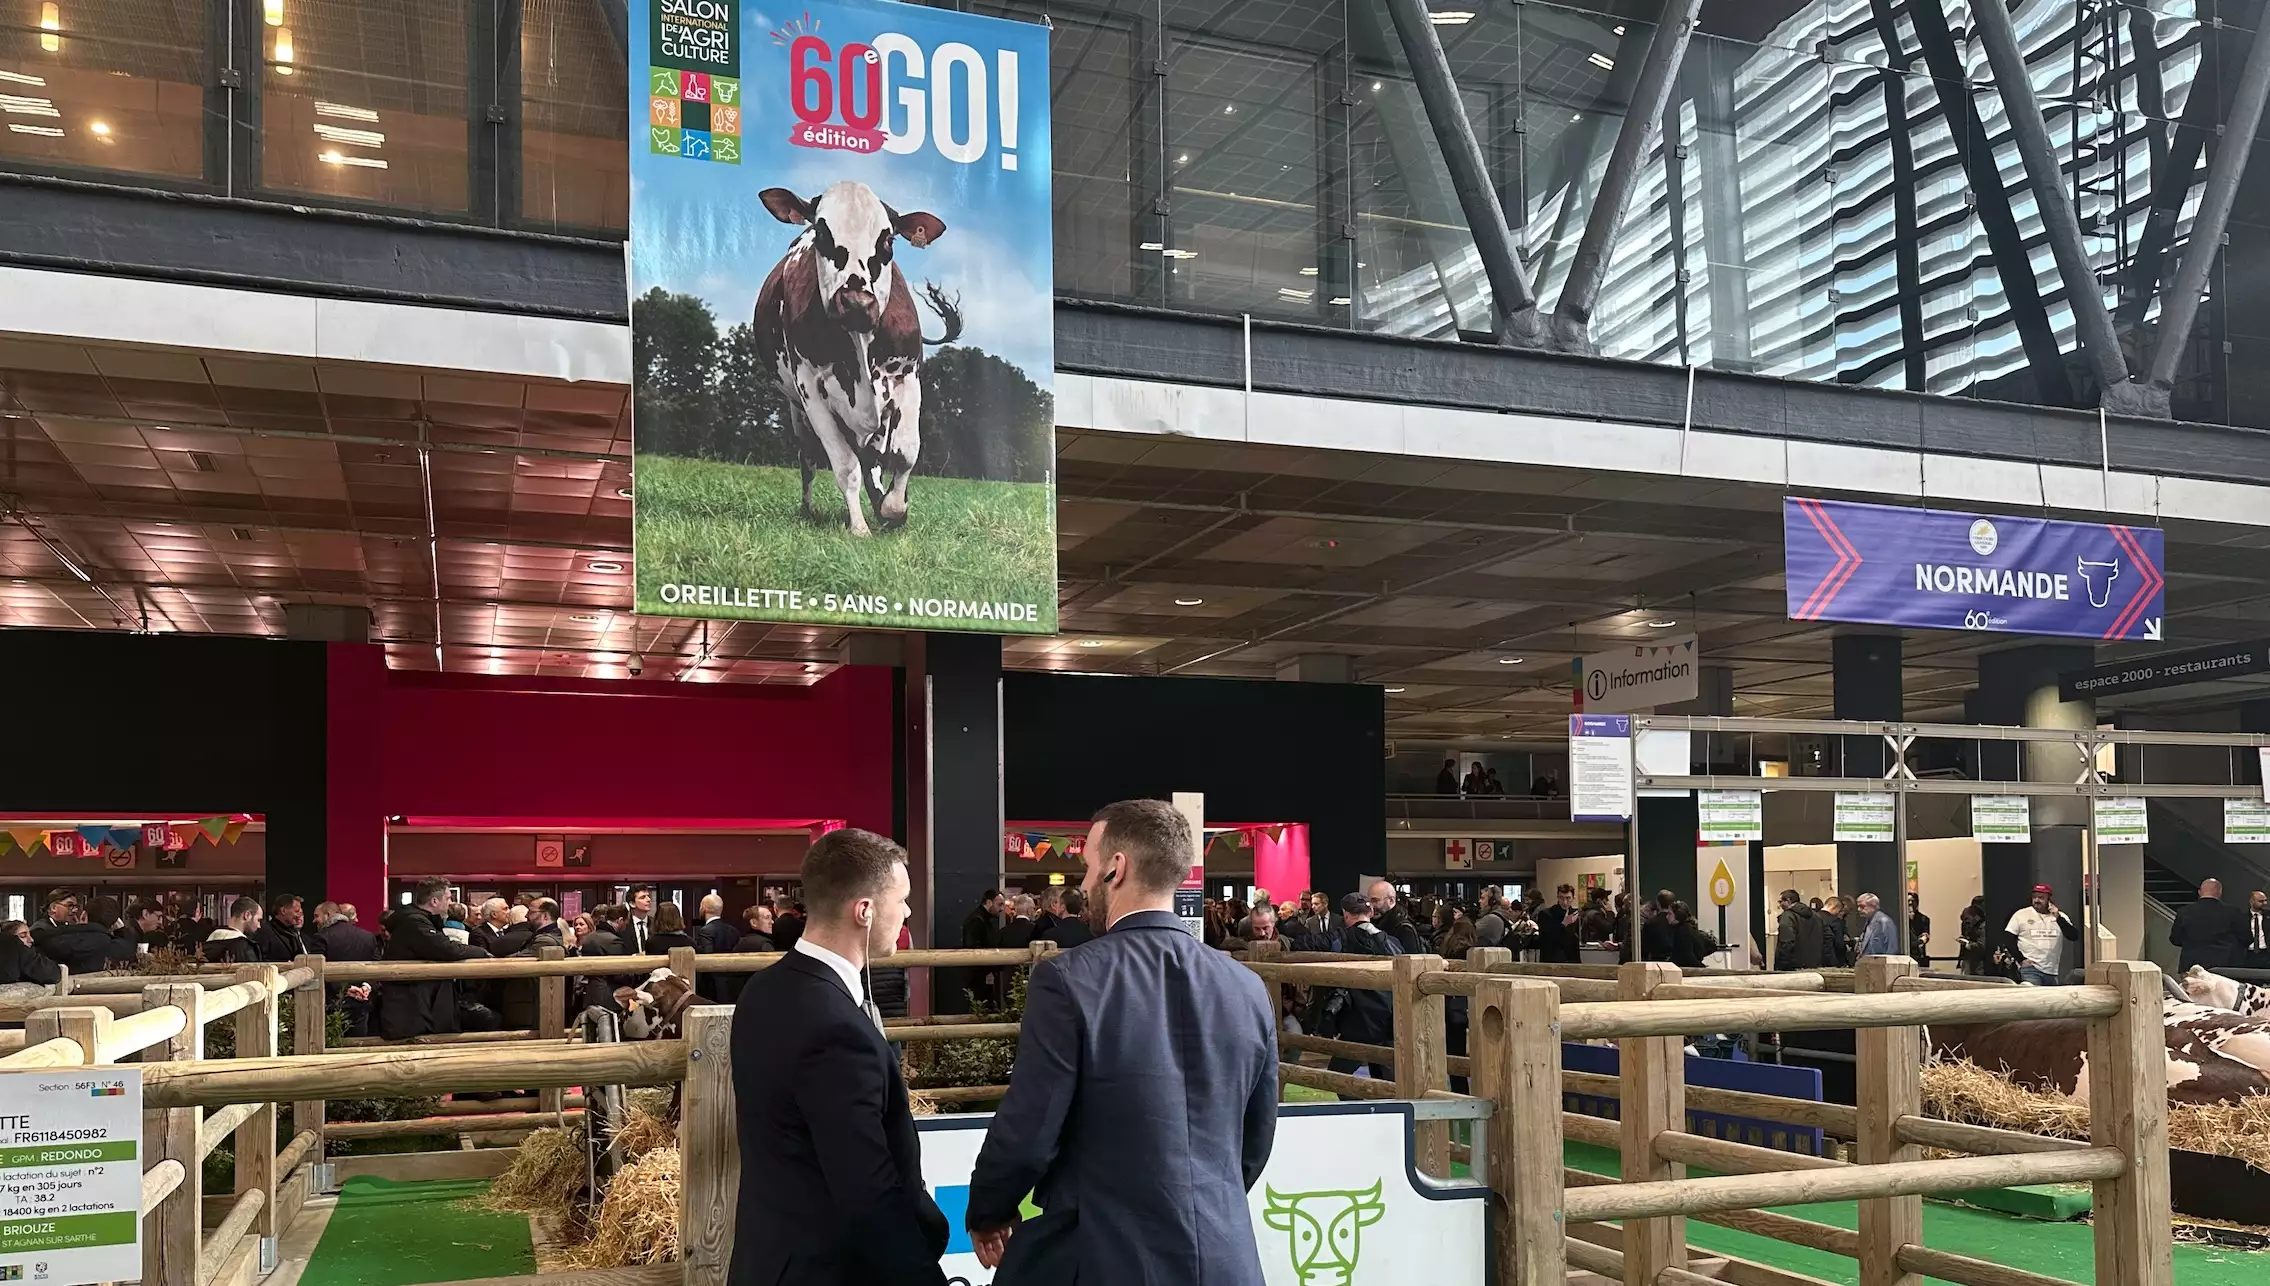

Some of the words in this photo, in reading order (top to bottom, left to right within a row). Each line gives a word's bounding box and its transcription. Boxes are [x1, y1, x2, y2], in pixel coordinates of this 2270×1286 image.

[660, 0, 729, 21] SALON
[661, 14, 729, 31] INTERNATIONAL
[661, 42, 729, 64] CULTURE
[871, 32, 1018, 171] GO!
[803, 125, 870, 150] édition
[1915, 563, 2069, 601] NORMANDE
[660, 583, 802, 610] OREILLETTE
[823, 593, 835, 612] 5
[836, 595, 888, 615] ANS
[909, 597, 1038, 622] NORMANDE
[1610, 660, 1689, 689] Information
[2075, 675, 2120, 690] espace
[2121, 668, 2153, 683] 2000
[2164, 653, 2251, 677] restaurants
[147, 827, 164, 842] 60
[39, 1083, 70, 1091] Section
[14, 1128, 107, 1144] FR6118450982
[12, 1154, 35, 1164] GPM
[41, 1149, 103, 1161] REDONDO
[3, 1169, 44, 1181] lactation
[45, 1169, 59, 1178] du
[60, 1168, 82, 1180] sujet
[7, 1184, 20, 1194] kg
[22, 1184, 35, 1192] en
[37, 1182, 56, 1191] 305
[57, 1180, 83, 1191] jours
[15, 1195, 28, 1204] TA
[34, 1193, 55, 1203] 38.2
[3, 1207, 32, 1216] 18400
[34, 1205, 46, 1216] kg
[47, 1206, 60, 1214] en
[61, 1205, 68, 1213] 2
[69, 1201, 115, 1213] lactations
[3, 1222, 56, 1236] BRIOUZE
[2, 1239, 13, 1248] ST
[14, 1237, 45, 1247] AGNAN
[46, 1235, 64, 1245] SUR
[64, 1233, 97, 1243] SARTHE
